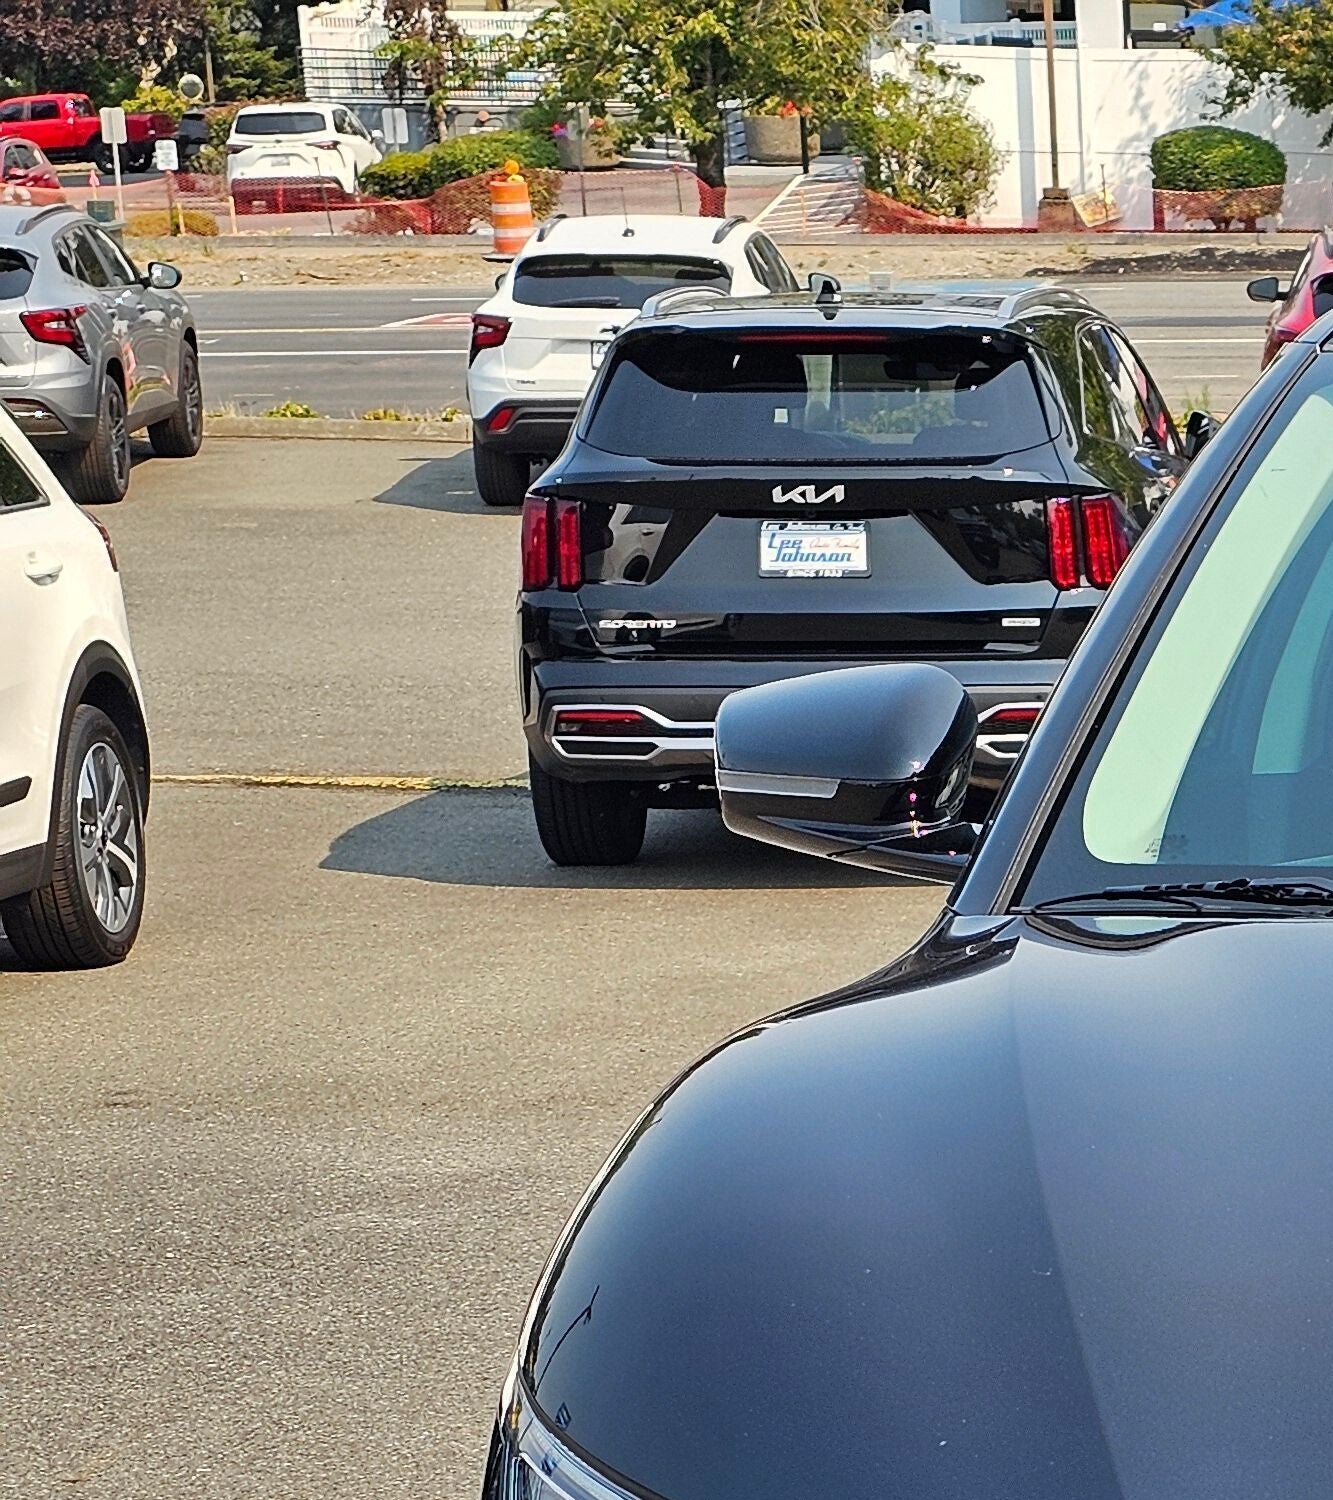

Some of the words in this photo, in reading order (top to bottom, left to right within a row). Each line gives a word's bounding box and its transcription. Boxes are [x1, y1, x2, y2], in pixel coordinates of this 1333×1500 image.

[772, 484, 845, 504] KIA
[768, 532, 803, 549] Lee
[770, 547, 857, 562] Johnson
